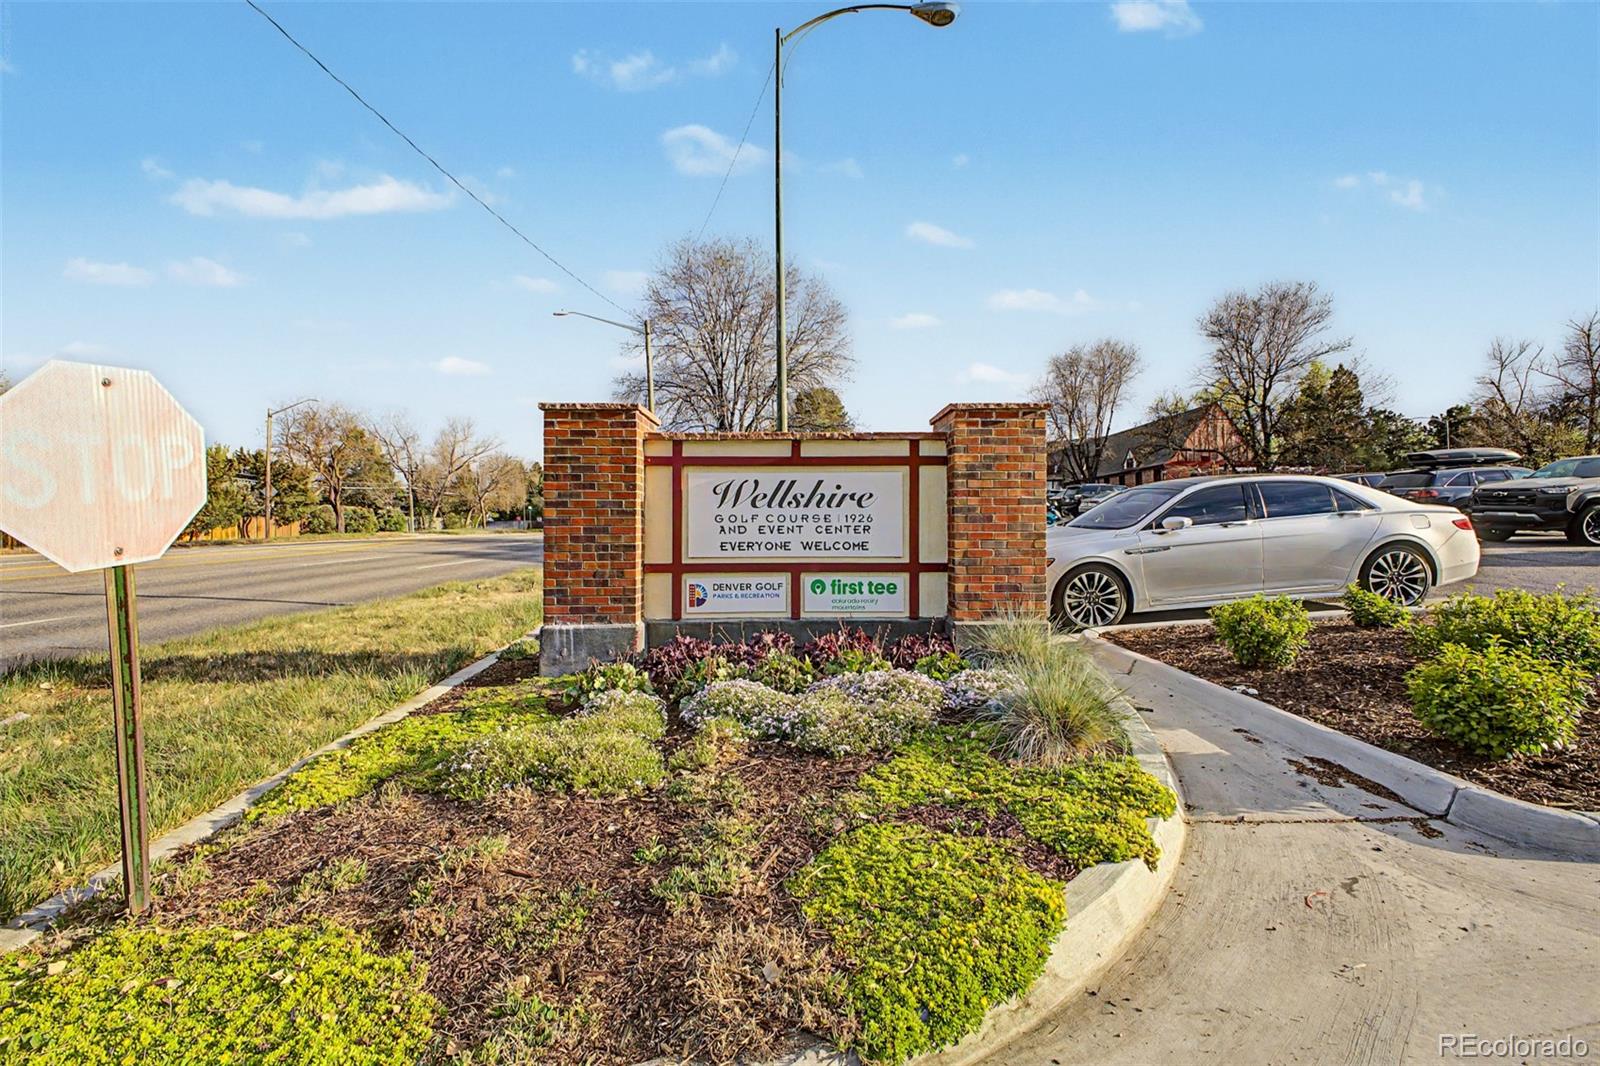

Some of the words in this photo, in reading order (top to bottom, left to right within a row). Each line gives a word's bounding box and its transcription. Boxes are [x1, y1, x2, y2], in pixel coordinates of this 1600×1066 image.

[2, 428, 194, 509] STOP
[712, 479, 877, 509] Wellshire
[714, 514, 759, 524] GOLF
[765, 514, 832, 524] COURSE
[844, 514, 874, 524] 1926
[719, 525, 747, 535] AND
[758, 525, 804, 535] EVENT
[815, 525, 872, 535] CENTER
[719, 541, 792, 551] EVERYONE
[800, 541, 870, 551] WELCOME
[712, 583, 752, 592] DENVER
[755, 583, 784, 591] GOLF
[830, 579, 864, 595] first
[867, 580, 898, 595] tee
